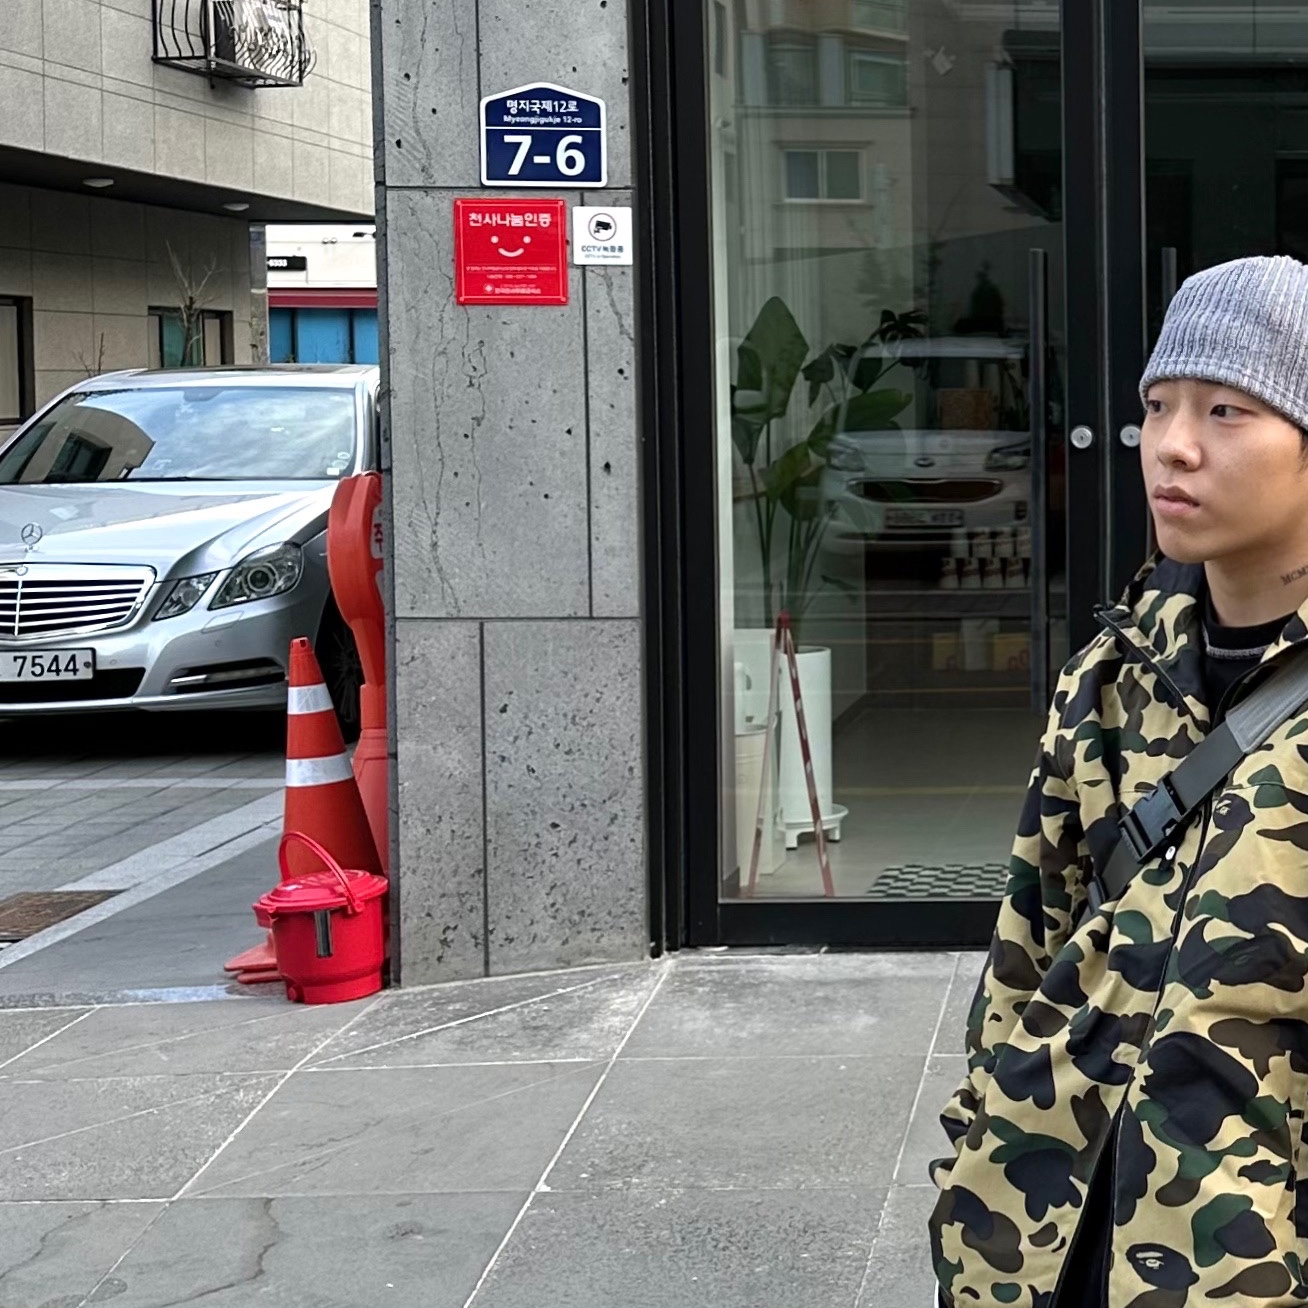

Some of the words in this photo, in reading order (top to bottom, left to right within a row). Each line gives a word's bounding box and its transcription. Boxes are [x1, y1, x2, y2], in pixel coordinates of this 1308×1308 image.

[506, 100, 579, 114] 명지국제12로
[503, 134, 586, 176] 7-6
[468, 212, 552, 228] 천사나눔인증
[13, 654, 80, 678] 7544
